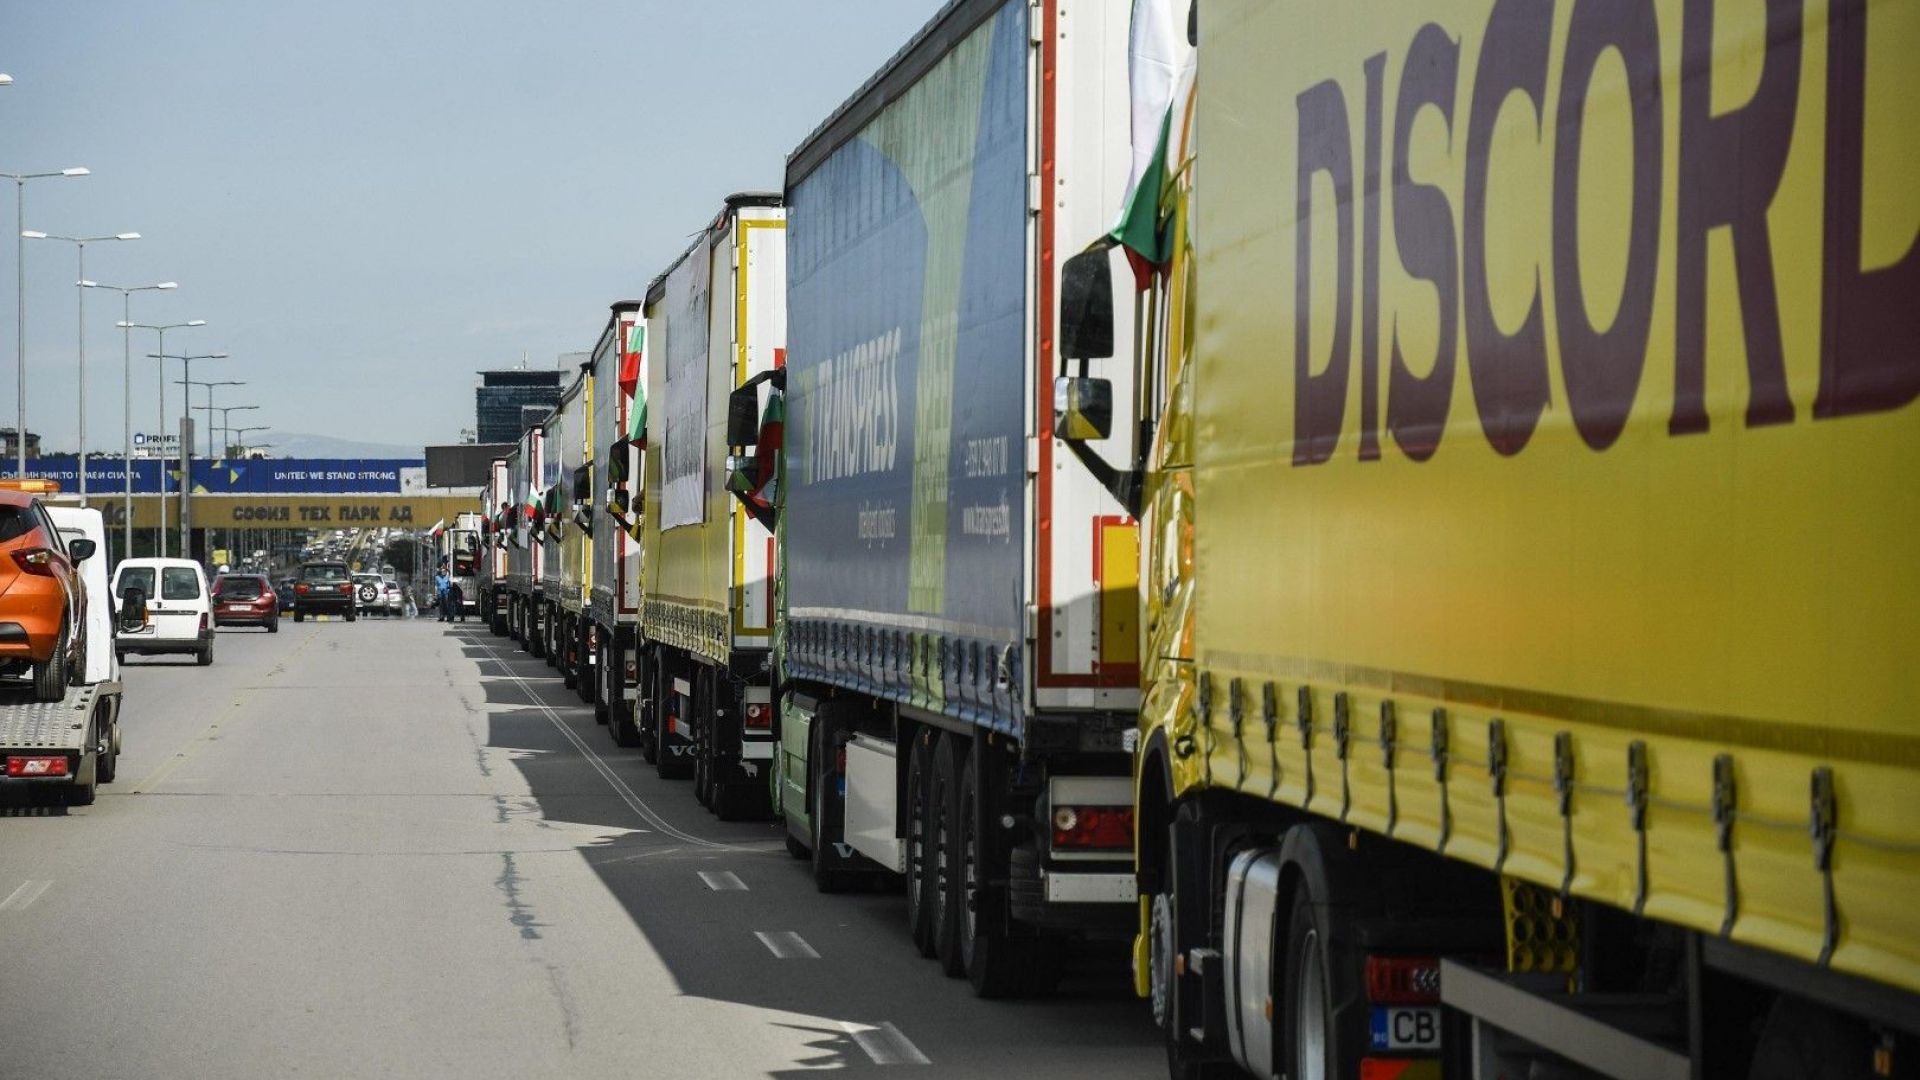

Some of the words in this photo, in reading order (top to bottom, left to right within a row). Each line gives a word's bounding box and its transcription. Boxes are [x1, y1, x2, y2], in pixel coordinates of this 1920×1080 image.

[274, 471, 307, 480] UNITED
[310, 471, 324, 480] WE
[326, 471, 356, 480] STAND
[358, 471, 396, 480] STRONG
[233, 506, 290, 521] СОФИЯ
[299, 506, 331, 521] ТЕХ
[339, 506, 380, 521] ПАРК
[388, 506, 413, 522] АД
